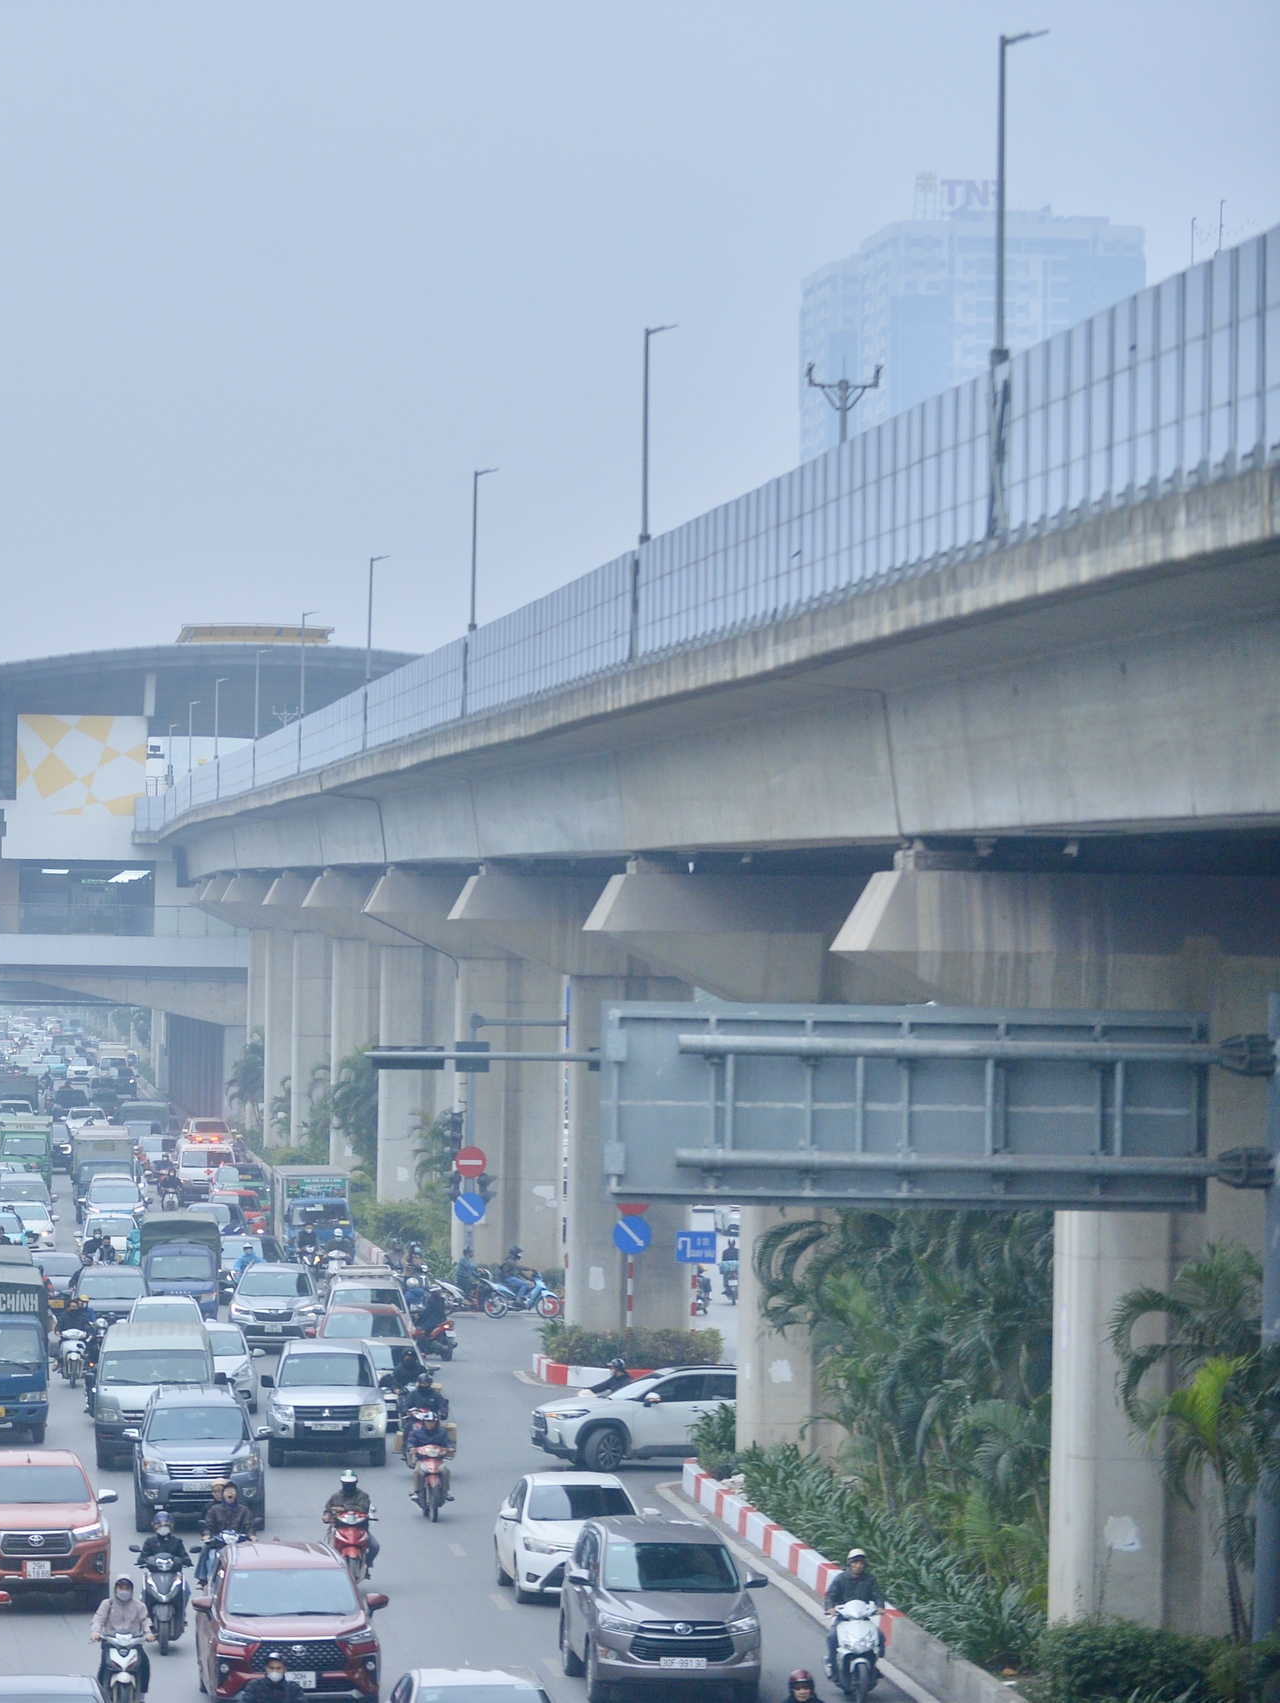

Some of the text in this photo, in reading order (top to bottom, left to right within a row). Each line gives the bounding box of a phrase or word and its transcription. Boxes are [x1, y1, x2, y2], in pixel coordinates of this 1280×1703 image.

[32, 1561, 45, 1570] 29H
[661, 1658, 705, 1668] 30F-991.90
[291, 1672, 306, 1680] 30H
